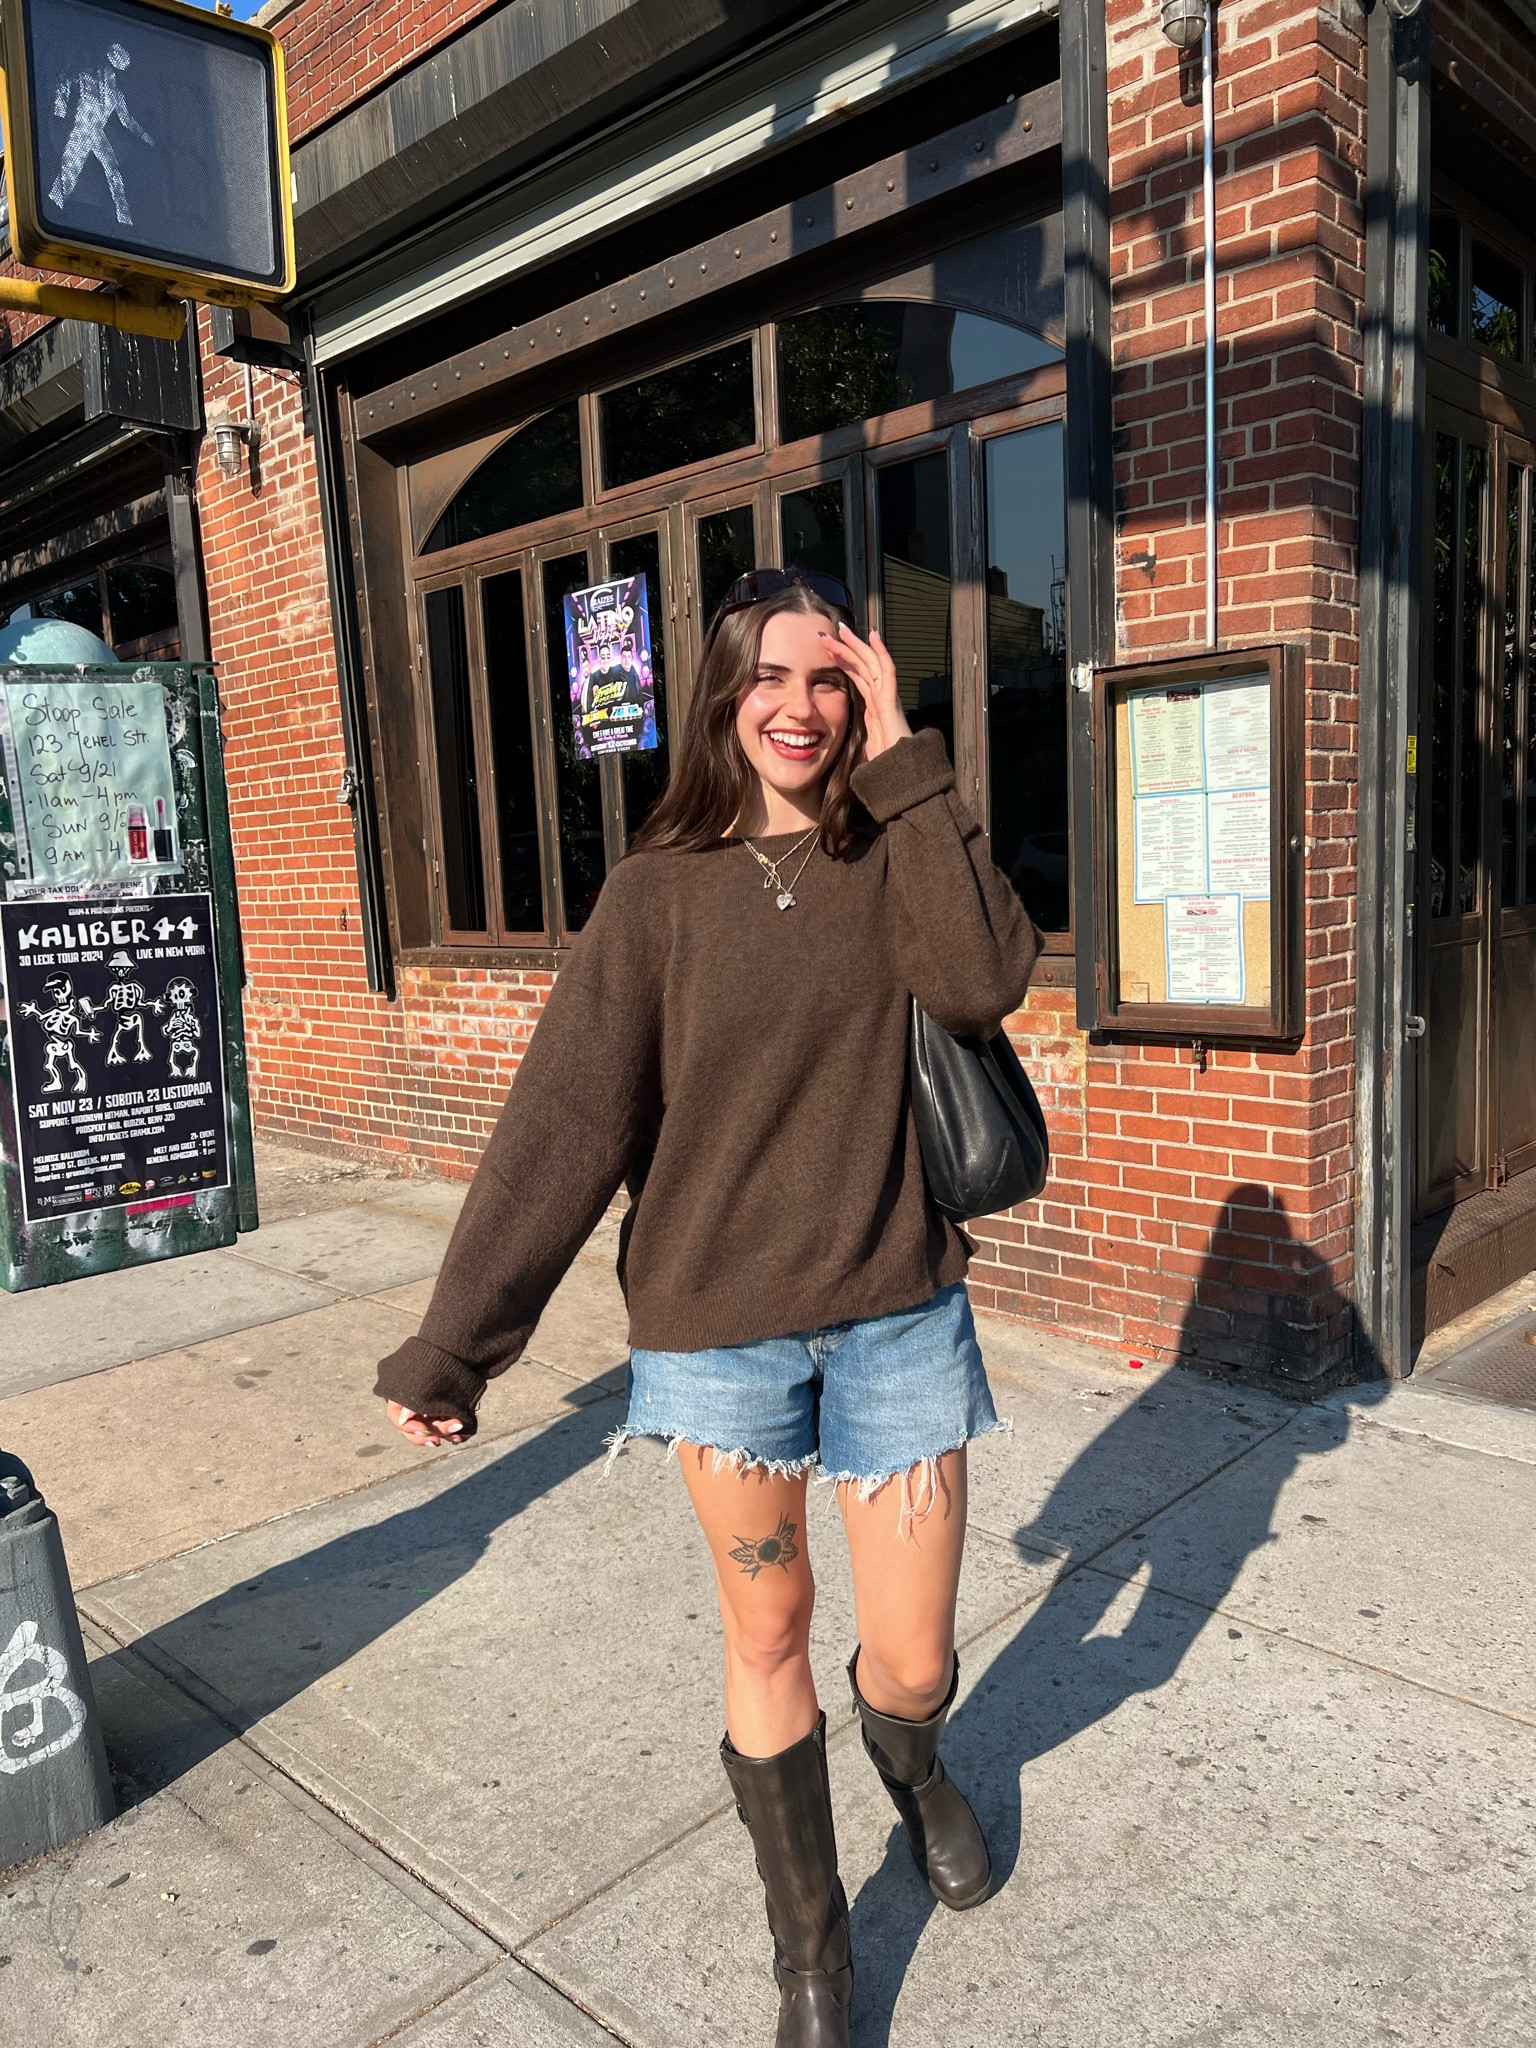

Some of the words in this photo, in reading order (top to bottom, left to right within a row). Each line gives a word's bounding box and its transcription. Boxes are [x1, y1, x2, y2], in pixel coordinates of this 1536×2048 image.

[578, 604, 634, 634] LATINO
[23, 693, 81, 732] Stoop
[93, 697, 137, 720] Sale
[29, 735, 63, 757] 123
[124, 729, 149, 746] Str.
[30, 763, 67, 786] Sat
[80, 760, 116, 783] 9/21
[1232, 791, 1256, 799] SEAFOOD
[120, 881, 143, 889] BEING
[18, 918, 150, 950] KALIBER
[19, 955, 31, 966] 30
[33, 954, 55, 966] LECIE
[57, 952, 79, 964] TOUR
[81, 950, 103, 962] 2024
[136, 948, 153, 960] LIVE
[155, 947, 164, 958] IN
[165, 946, 184, 957] NEW
[185, 945, 205, 955] YORK
[28, 1103, 50, 1118] SAT
[52, 1100, 76, 1116] NOV
[79, 1097, 93, 1112] 23
[105, 1091, 145, 1109] SOBOTA
[147, 1089, 160, 1102] 23
[162, 1081, 213, 1101] LISTOPADA
[39, 1117, 70, 1129] SUPPORT:
[71, 1112, 103, 1125] BROOKLYN
[89, 1131, 129, 1144] INFO/TICKETS
[130, 1125, 165, 1138] GRAMX.COM
[199, 1129, 215, 1139] EVENT
[60, 1149, 90, 1161] BALLROOM
[153, 1145, 167, 1156] MEET
[168, 1143, 180, 1153] AND
[180, 1141, 196, 1151] GREET
[100, 1155, 110, 1164] NY
[146, 1155, 169, 1165] GENERAL
[170, 1150, 199, 1162] ADMISSION
